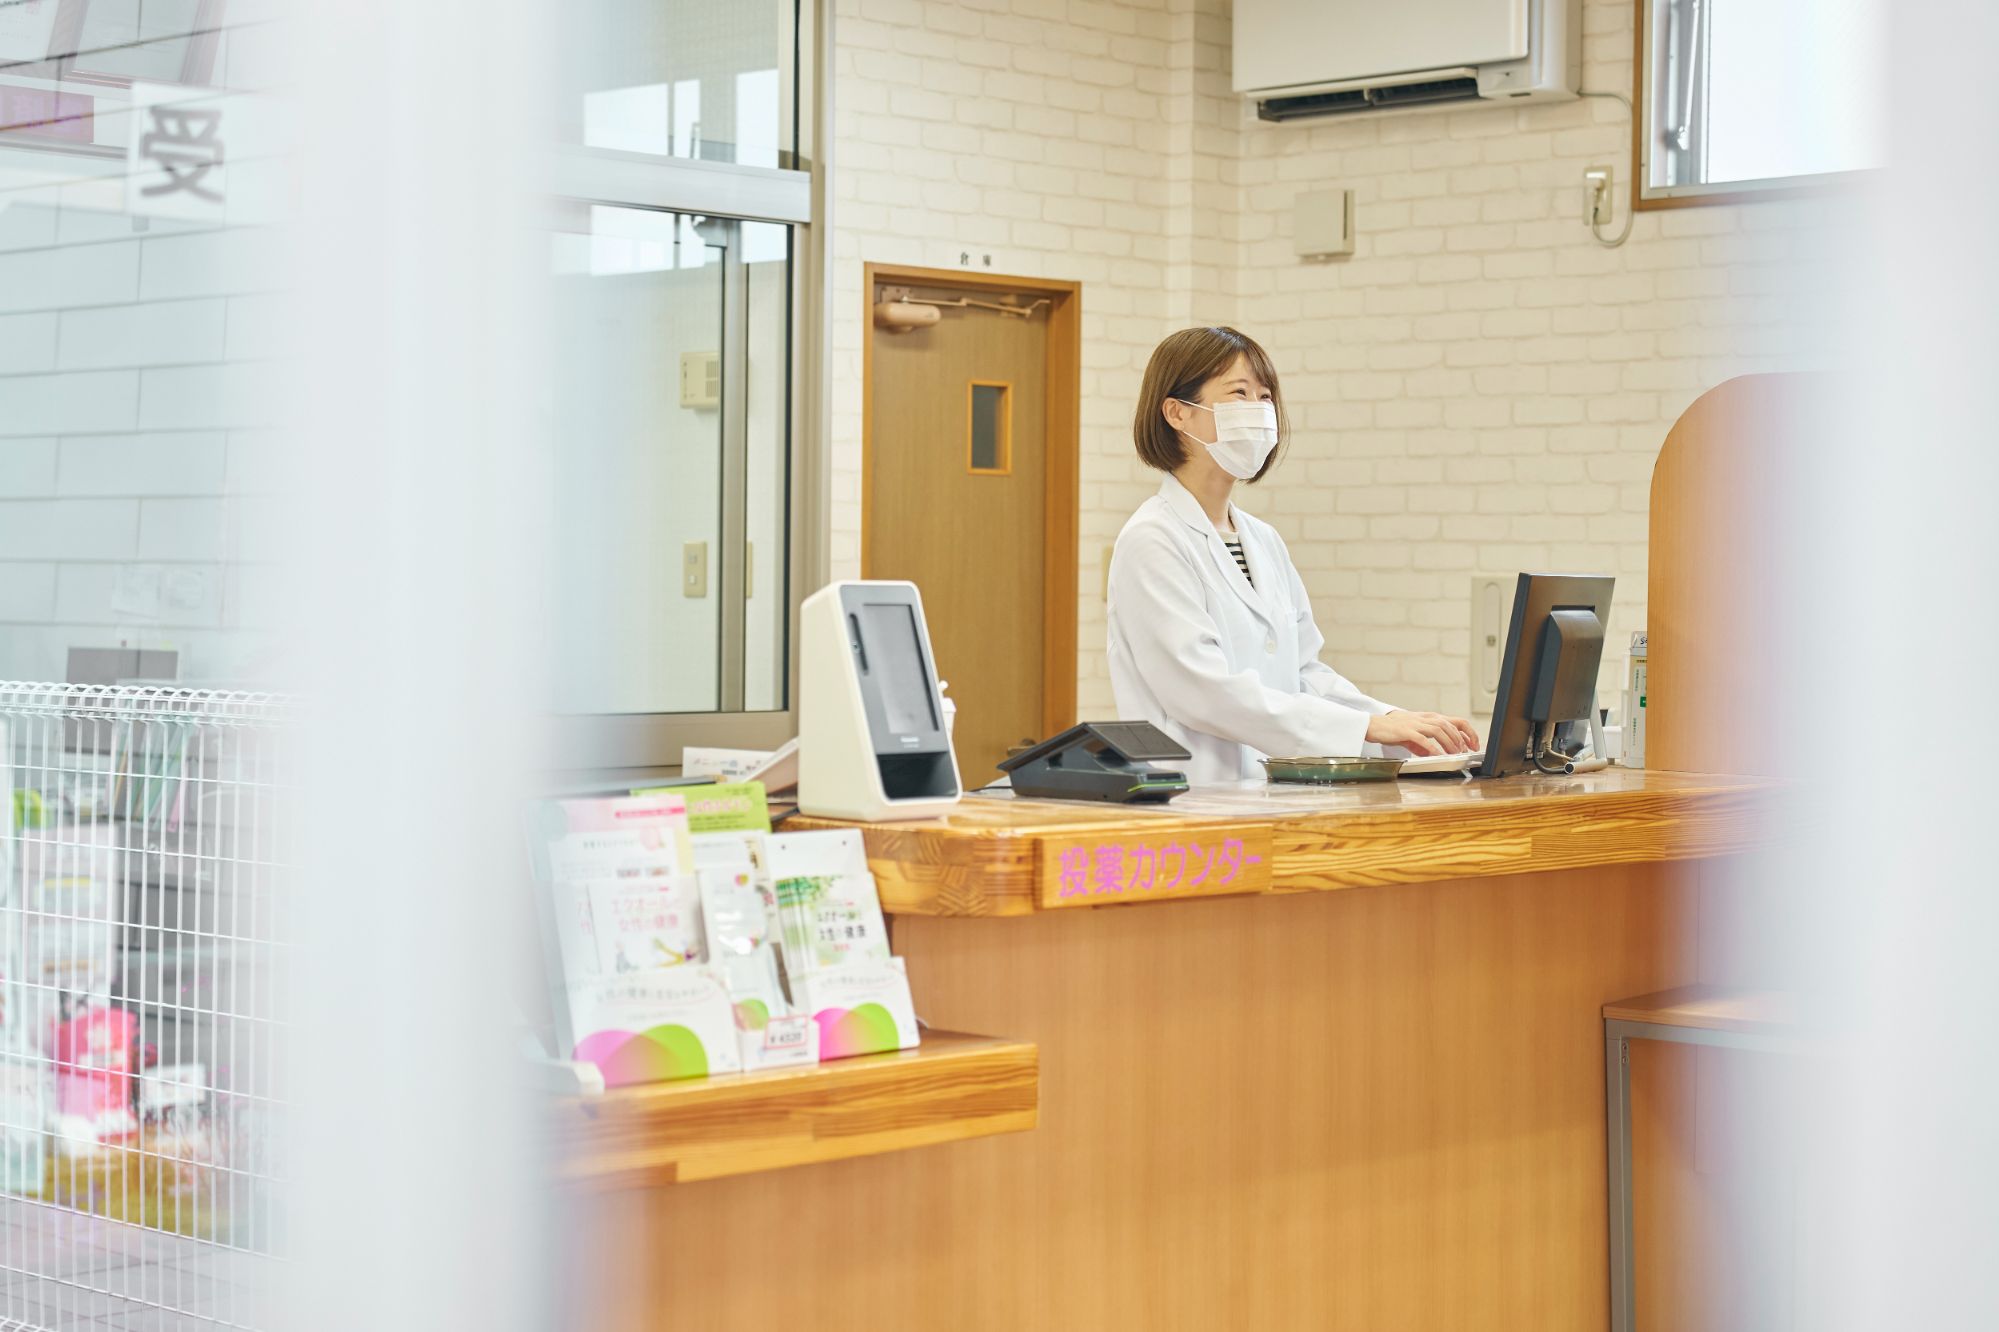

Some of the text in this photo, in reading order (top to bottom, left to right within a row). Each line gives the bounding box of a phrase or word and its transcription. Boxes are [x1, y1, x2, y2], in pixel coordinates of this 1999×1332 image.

[1059, 837, 1262, 897] 投薬カウンター
